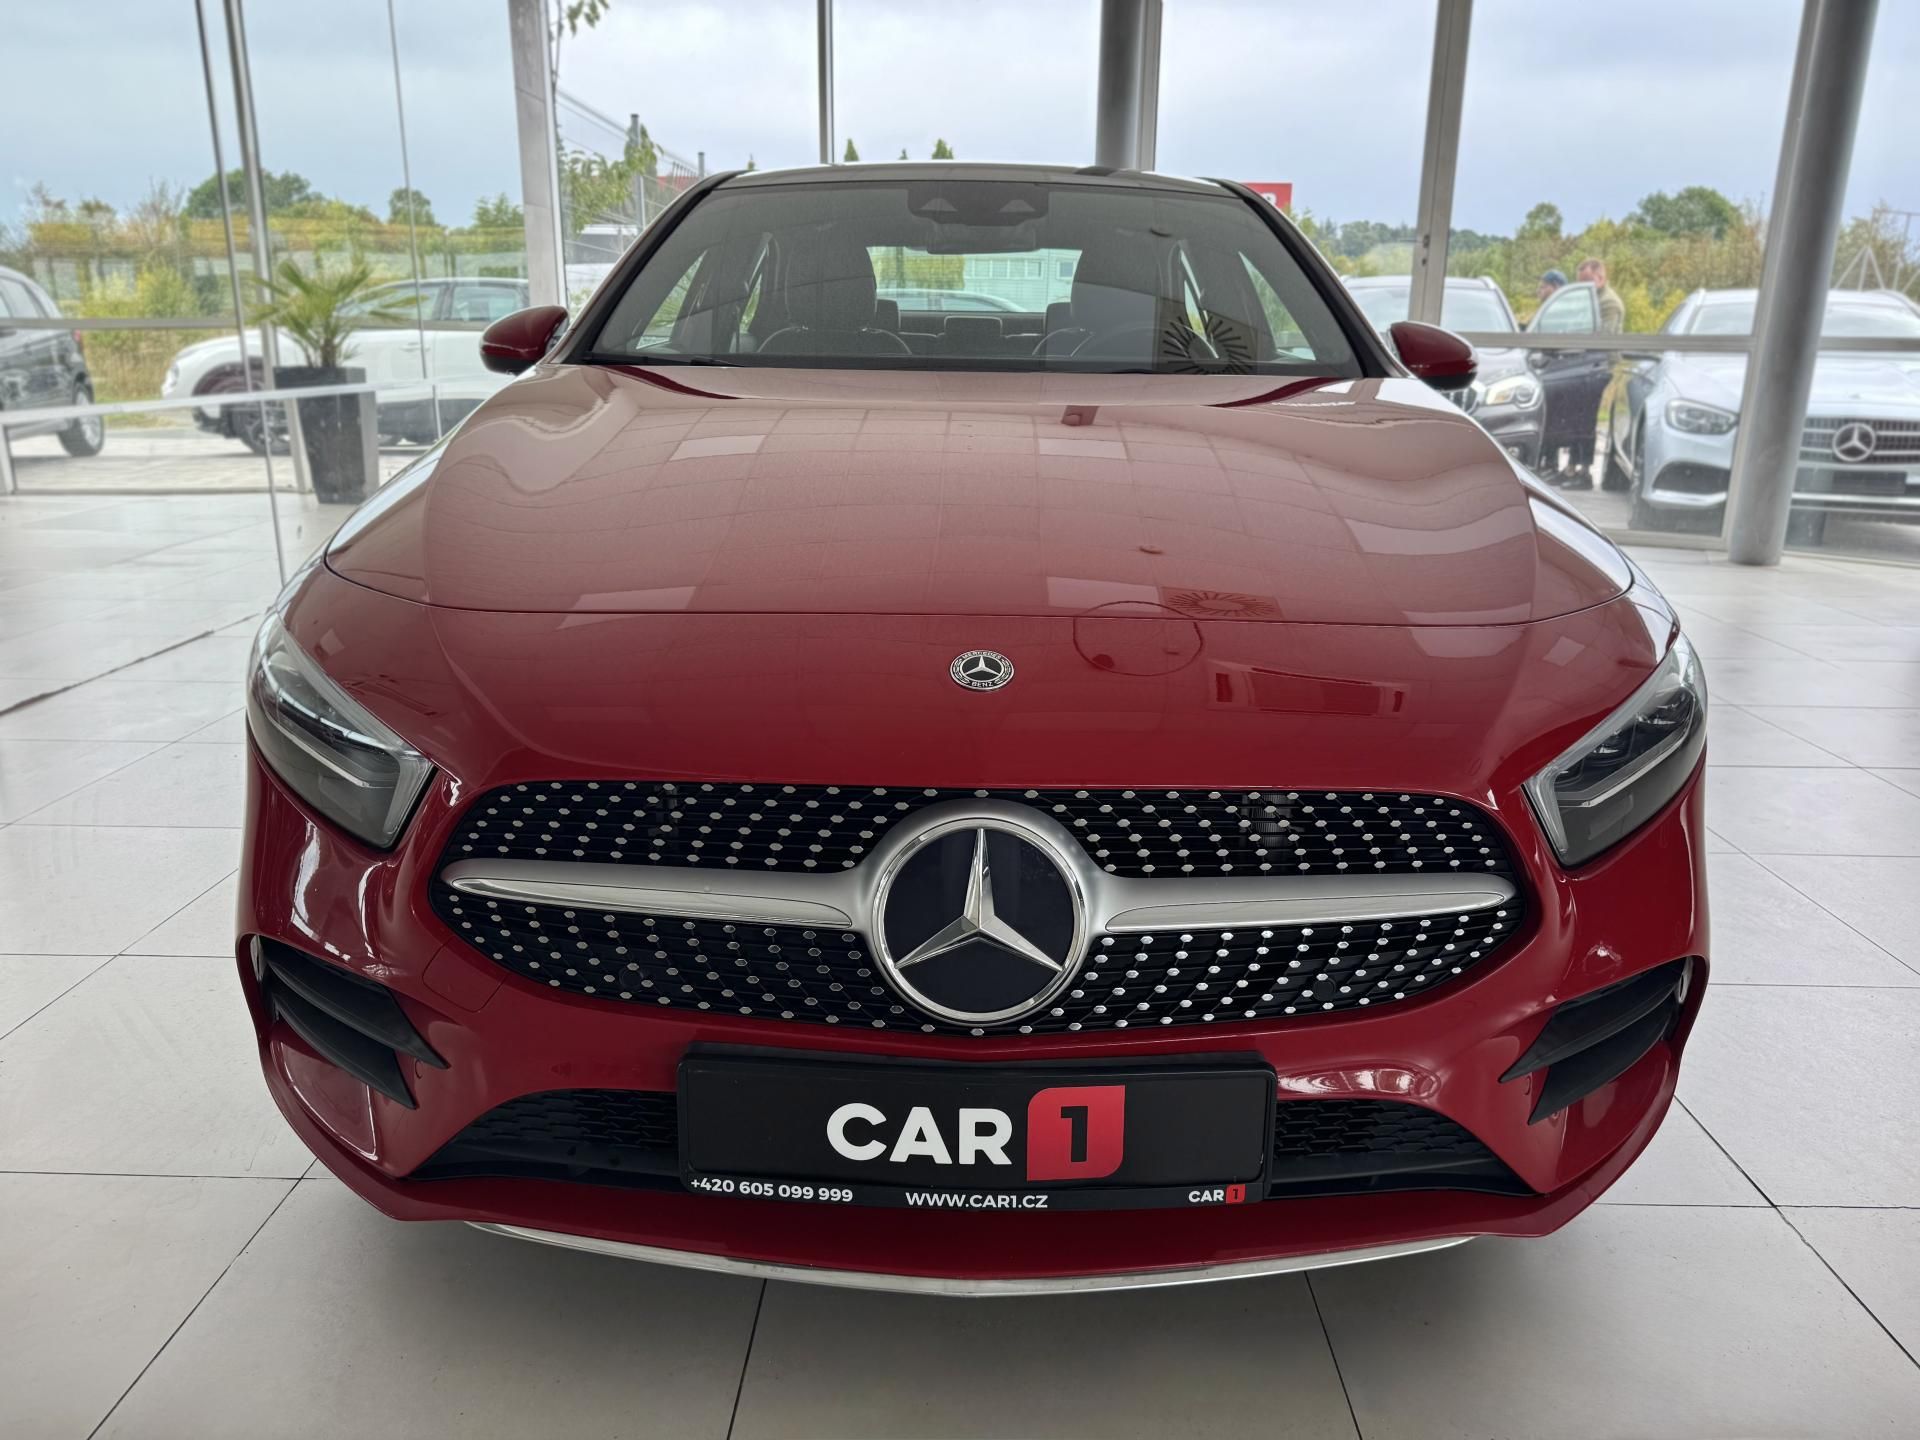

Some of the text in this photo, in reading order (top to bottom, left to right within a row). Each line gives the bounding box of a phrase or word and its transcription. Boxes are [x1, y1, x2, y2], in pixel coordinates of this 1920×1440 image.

[826, 1102, 1089, 1165] CAR 1
[691, 1177, 853, 1202] +420 605 099 999
[1188, 1188, 1239, 1203] CAR 1
[905, 1192, 1048, 1208] WWW.CAR1.CZ
